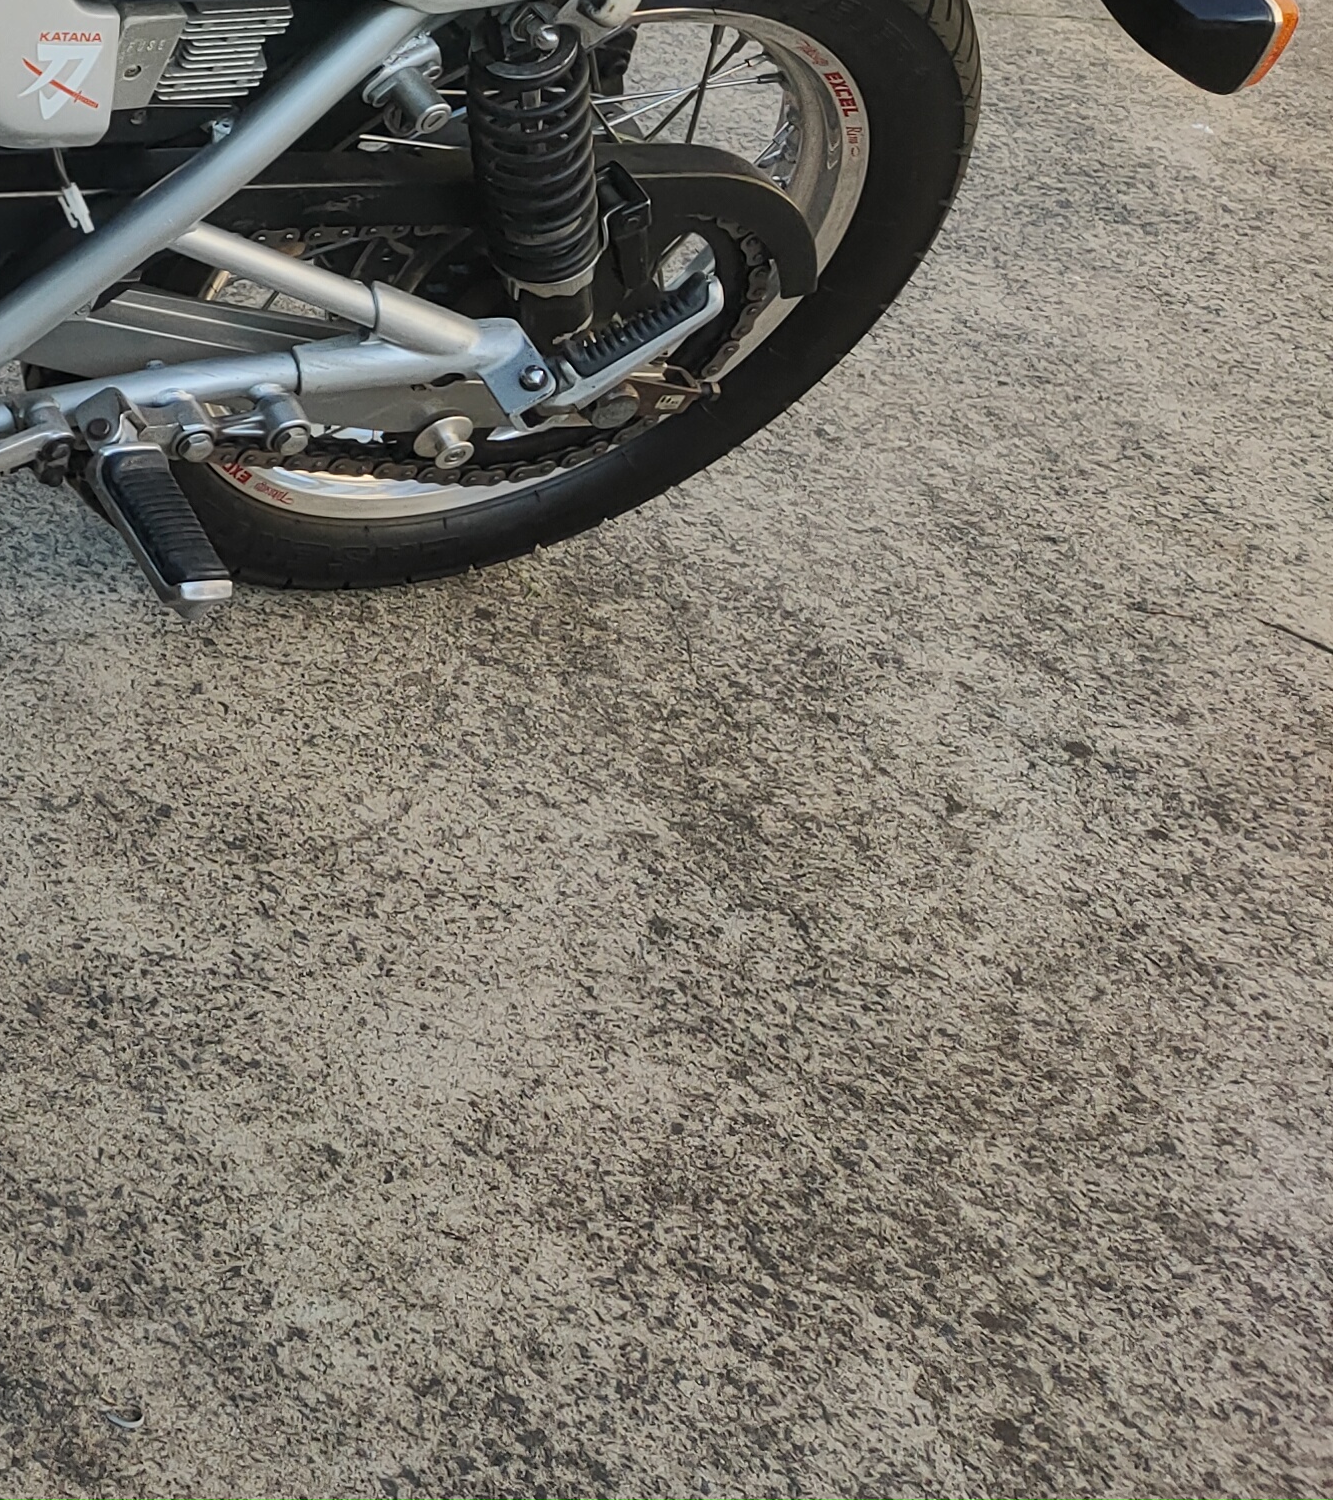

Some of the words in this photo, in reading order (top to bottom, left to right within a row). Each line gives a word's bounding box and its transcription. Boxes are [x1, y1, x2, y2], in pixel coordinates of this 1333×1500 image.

[39, 32, 102, 43] KATANA
[126, 39, 167, 53] FUSE
[823, 70, 859, 118] EXCEL
